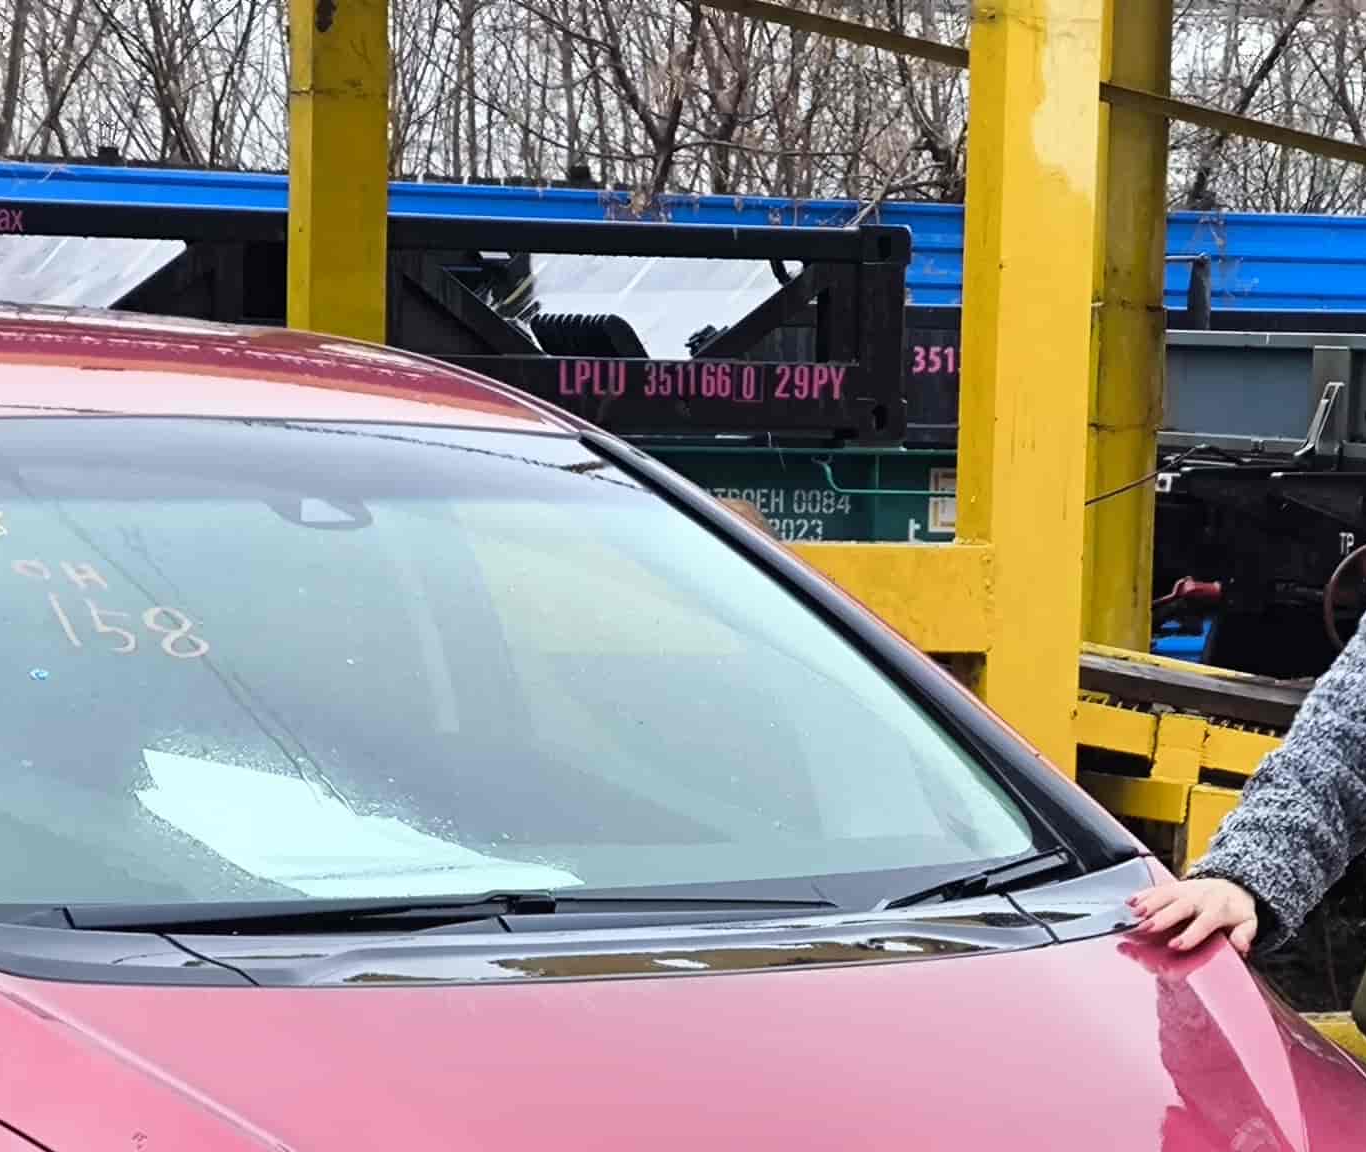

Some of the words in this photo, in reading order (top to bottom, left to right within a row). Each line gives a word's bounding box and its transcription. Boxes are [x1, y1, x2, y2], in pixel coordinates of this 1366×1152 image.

[559, 360, 626, 396] LPLU
[775, 366, 846, 399] 29PY
[793, 489, 852, 515] 0084
[48, 592, 210, 658] 158
